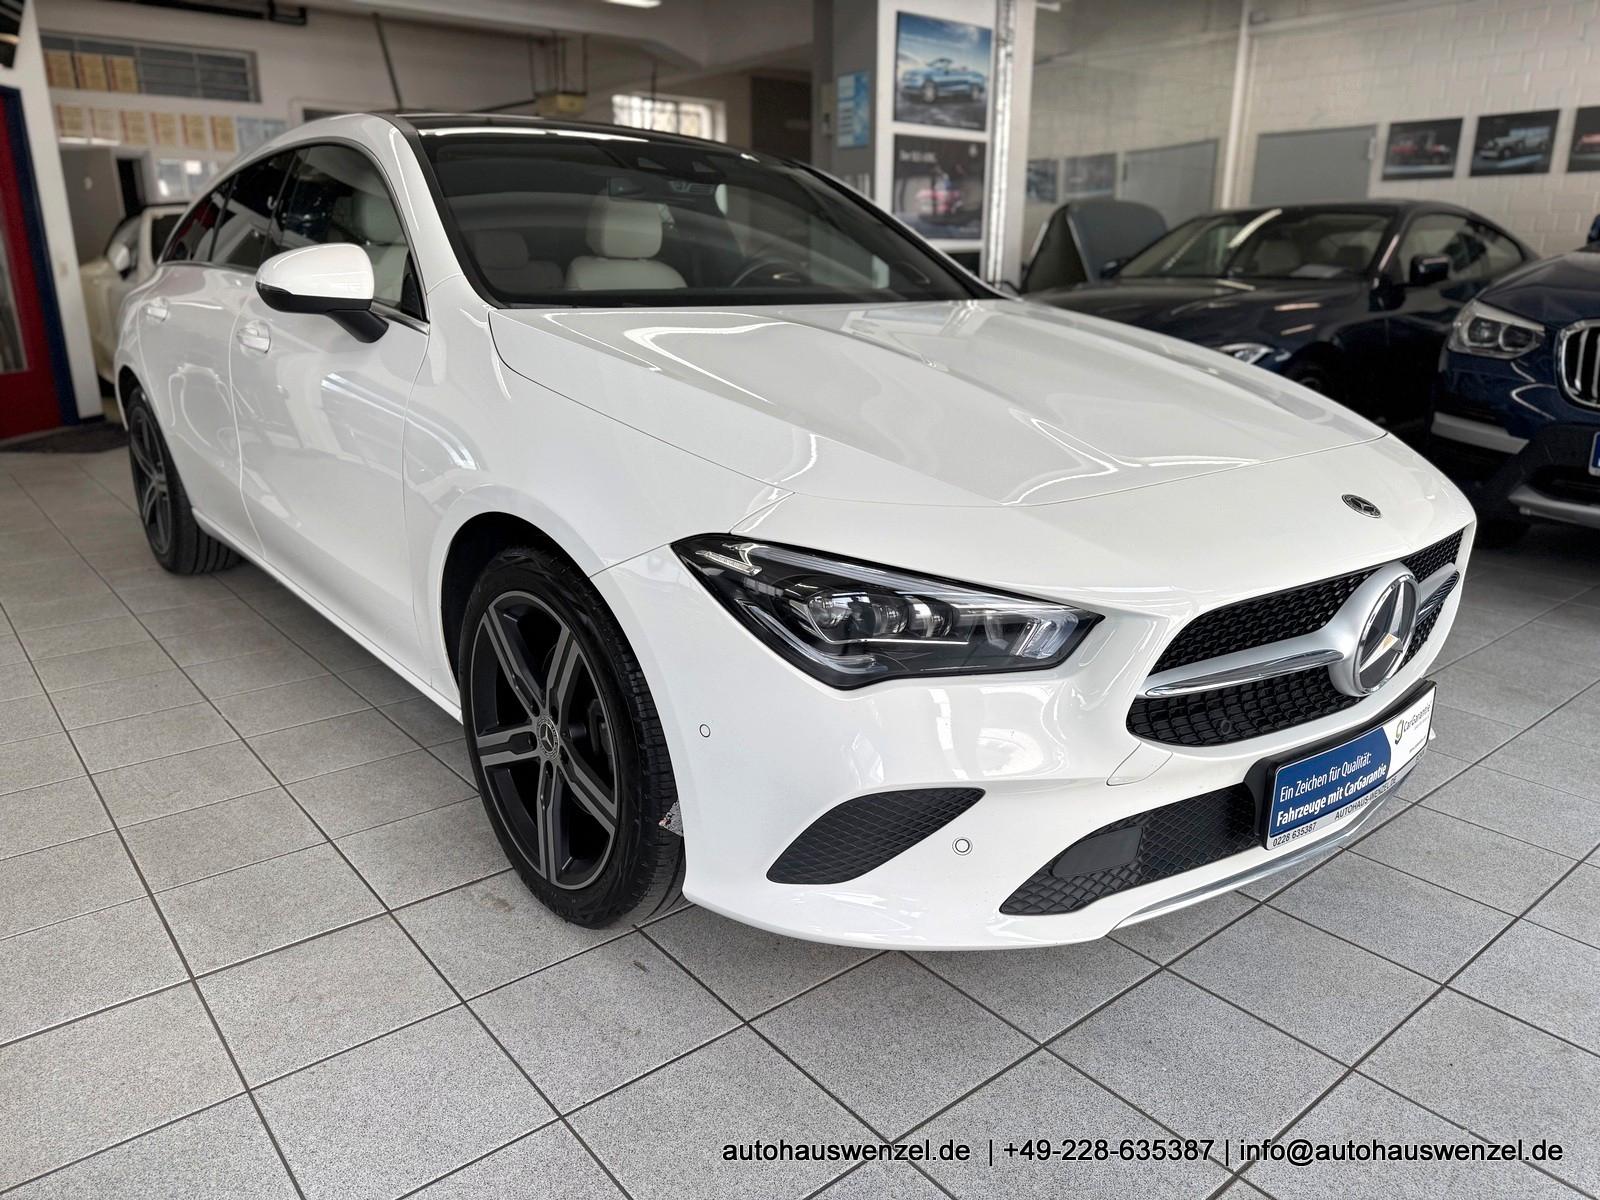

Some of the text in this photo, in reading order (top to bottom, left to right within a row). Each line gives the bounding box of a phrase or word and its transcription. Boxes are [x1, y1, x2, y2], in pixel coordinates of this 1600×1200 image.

[1276, 763, 1387, 828] Fahrzeuge mit CarGarantie
[1280, 752, 1372, 803] Ein Zeichen für Qualität:
[1272, 831, 1290, 848] 0228
[1291, 821, 1318, 841] 635387
